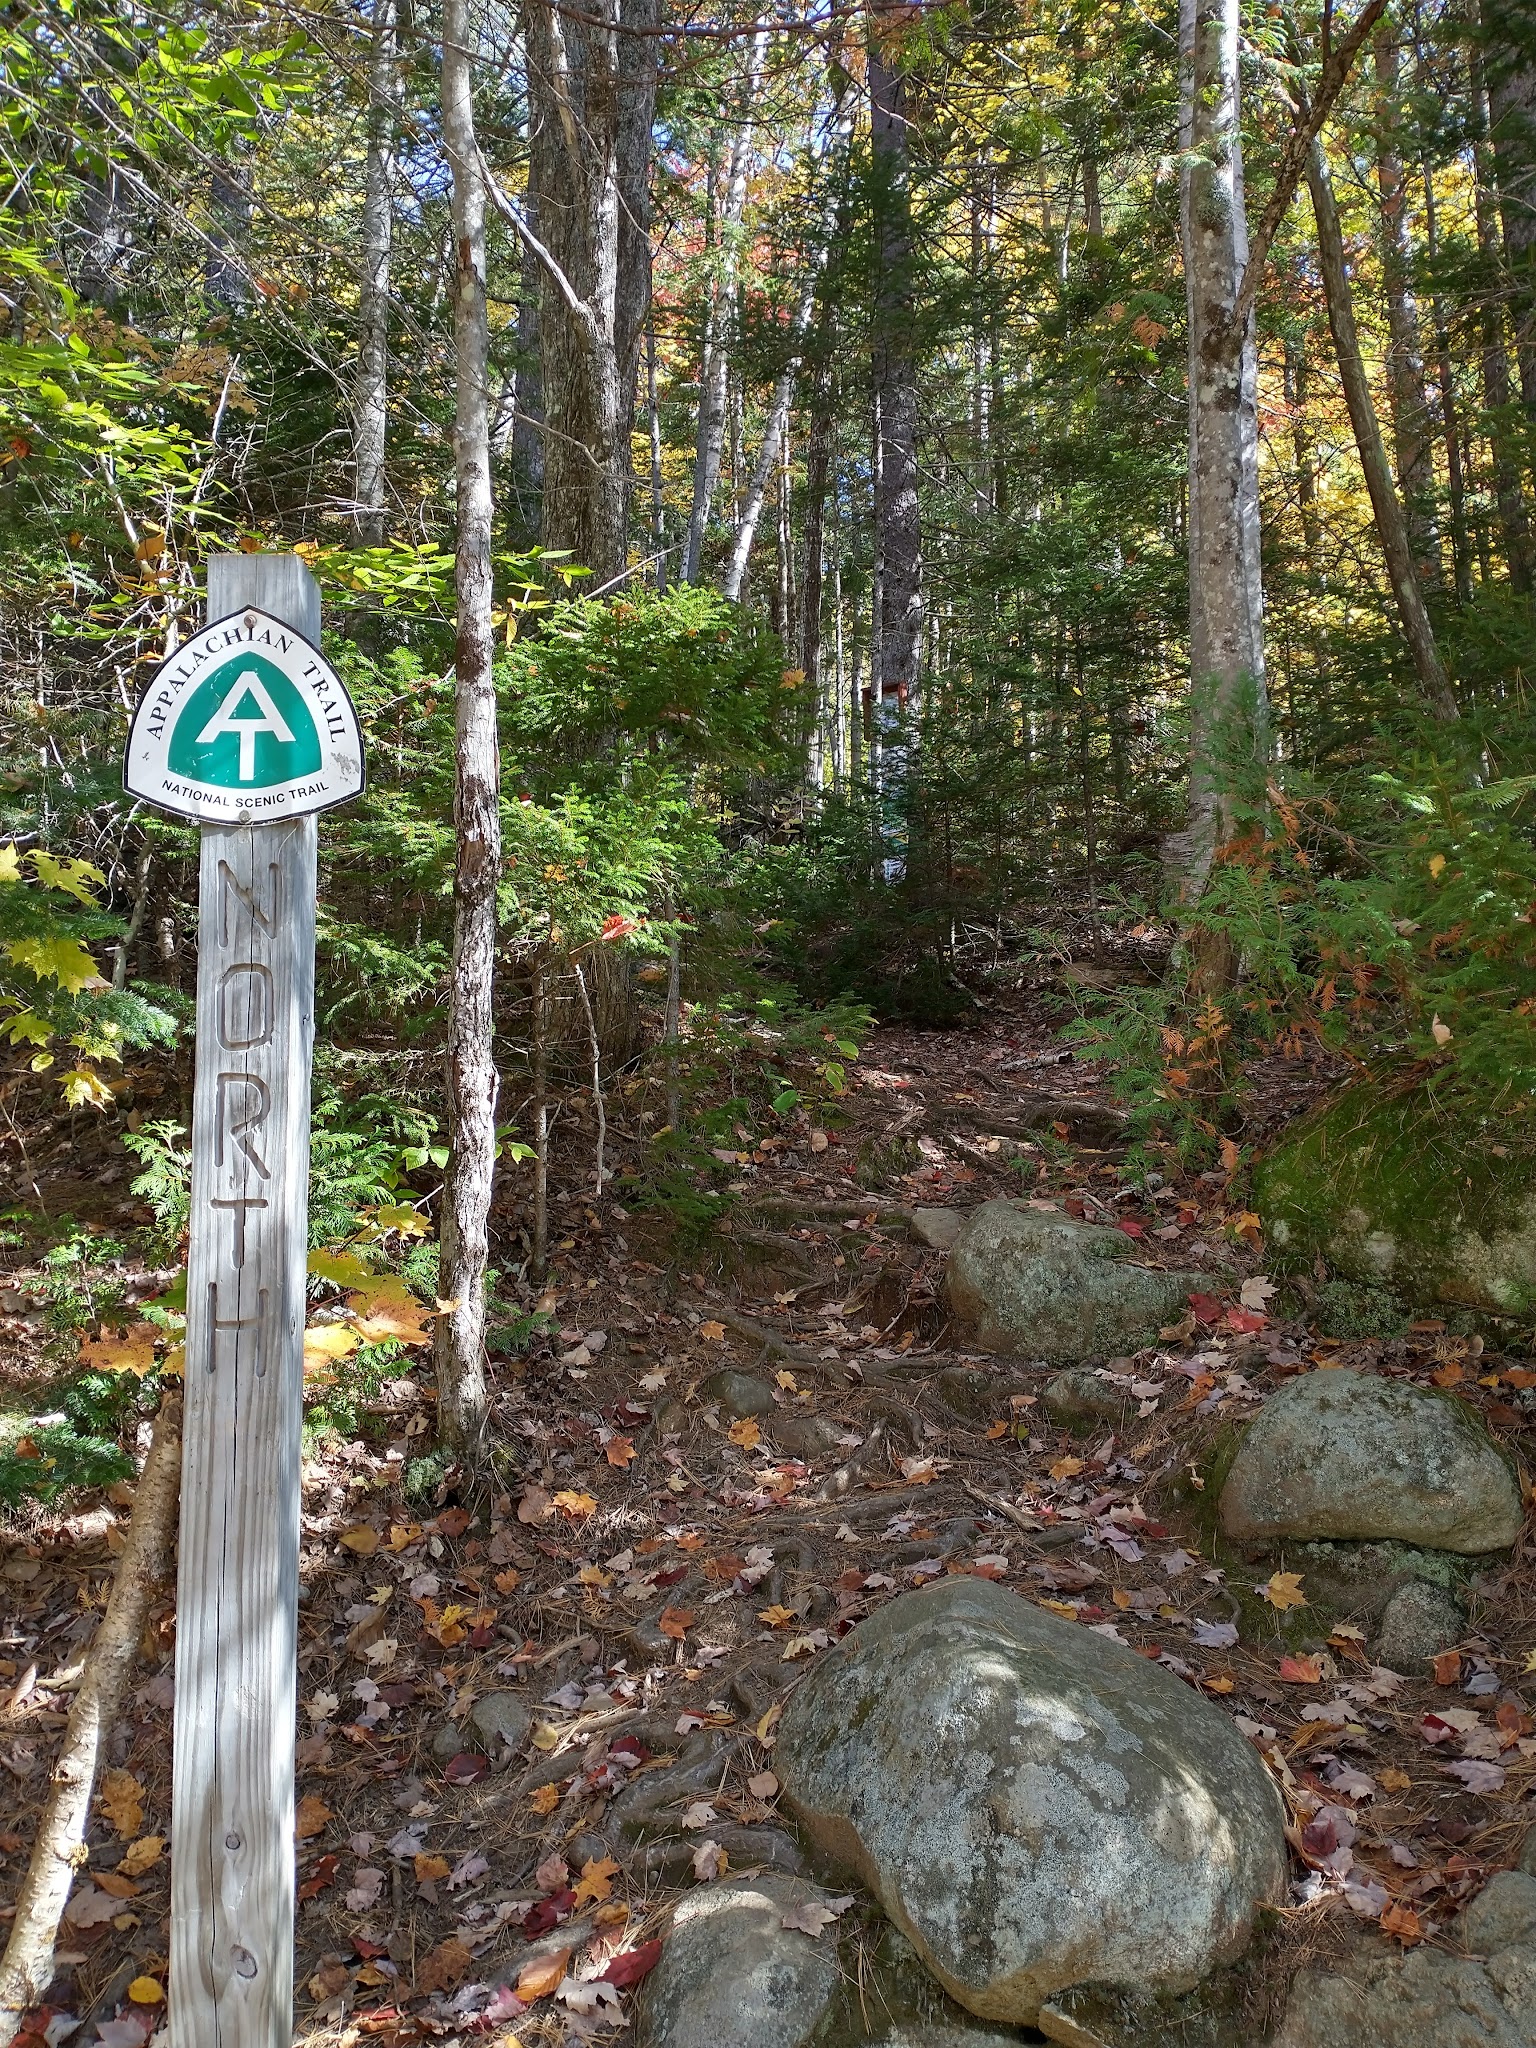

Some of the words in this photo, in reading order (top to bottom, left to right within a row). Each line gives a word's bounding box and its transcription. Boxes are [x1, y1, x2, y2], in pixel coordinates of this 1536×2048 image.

[146, 626, 295, 741] APPALACHIAN
[302, 660, 346, 743] TRAIL
[161, 779, 230, 807] NATIONAL
[235, 792, 286, 808] SCENIC
[288, 781, 330, 799] TRAIL
[206, 859, 279, 1378] NORTH
